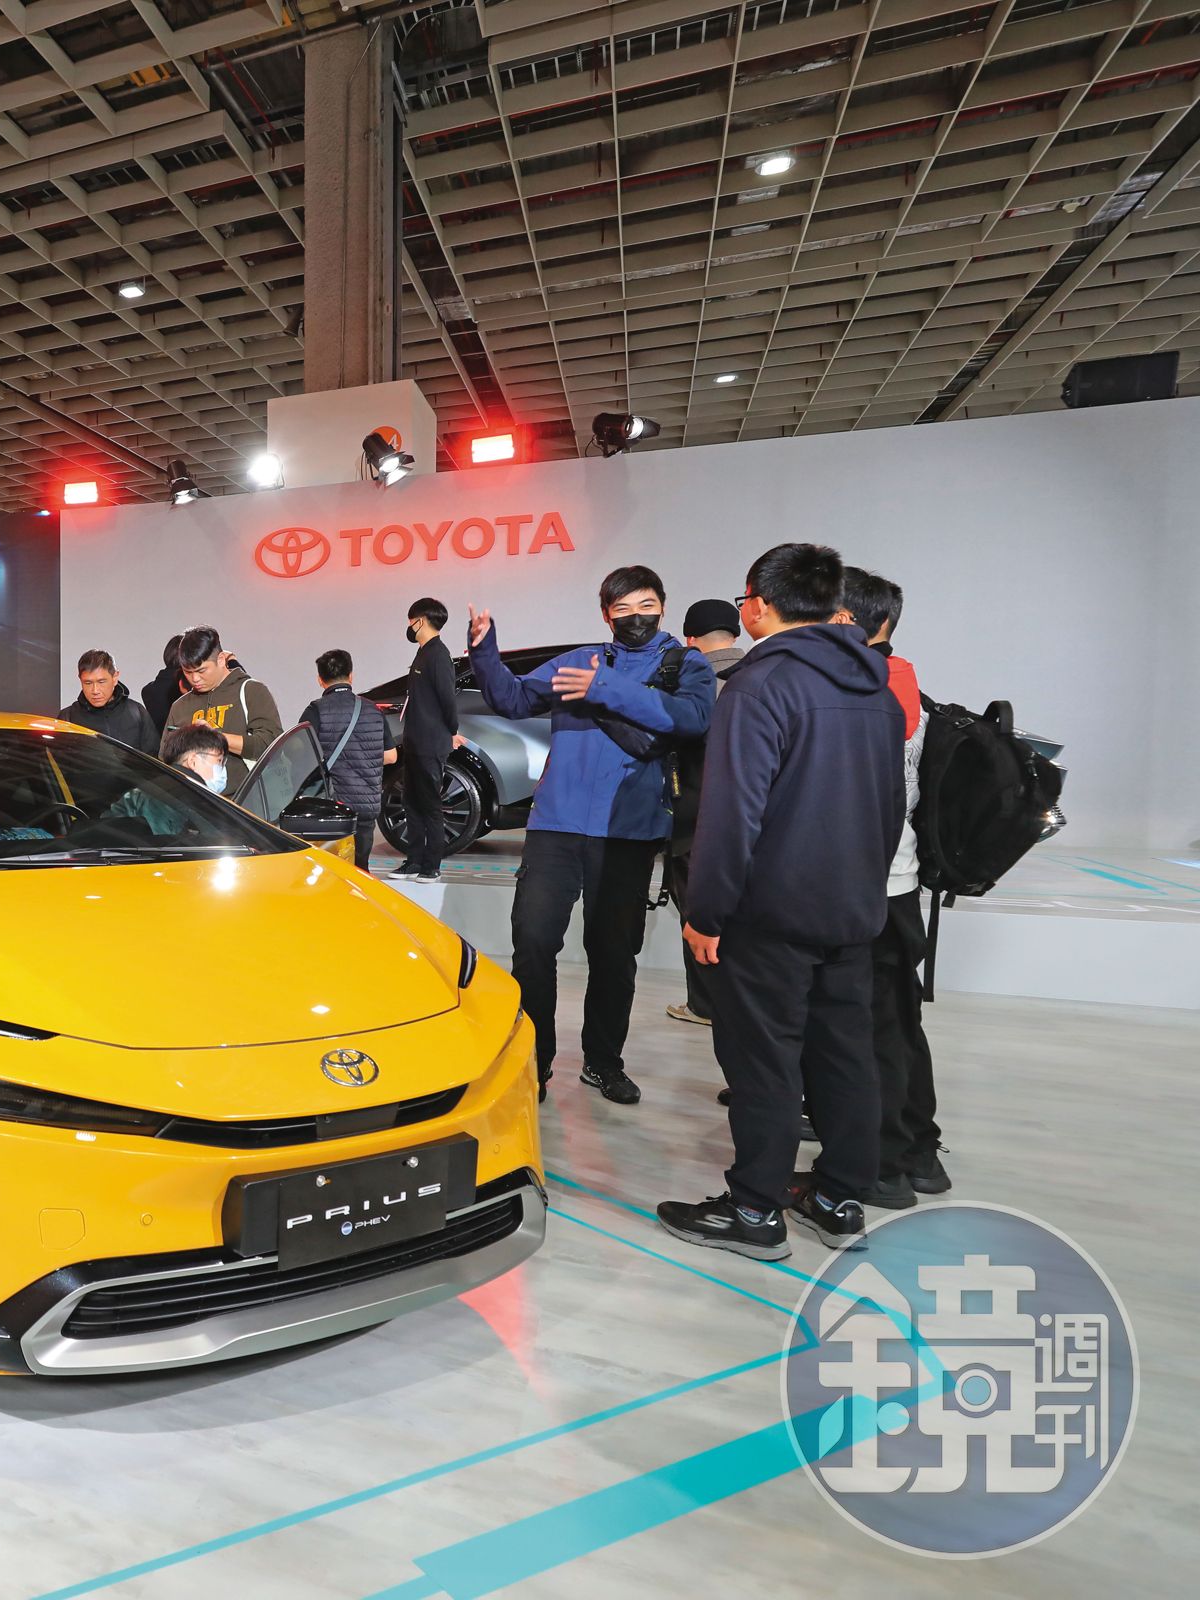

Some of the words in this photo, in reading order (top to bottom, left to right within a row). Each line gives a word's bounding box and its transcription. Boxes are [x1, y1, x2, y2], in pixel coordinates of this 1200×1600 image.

[339, 511, 575, 567] TOYOTA
[286, 1183, 442, 1230] PRIUS
[354, 1214, 392, 1230] PHEV
